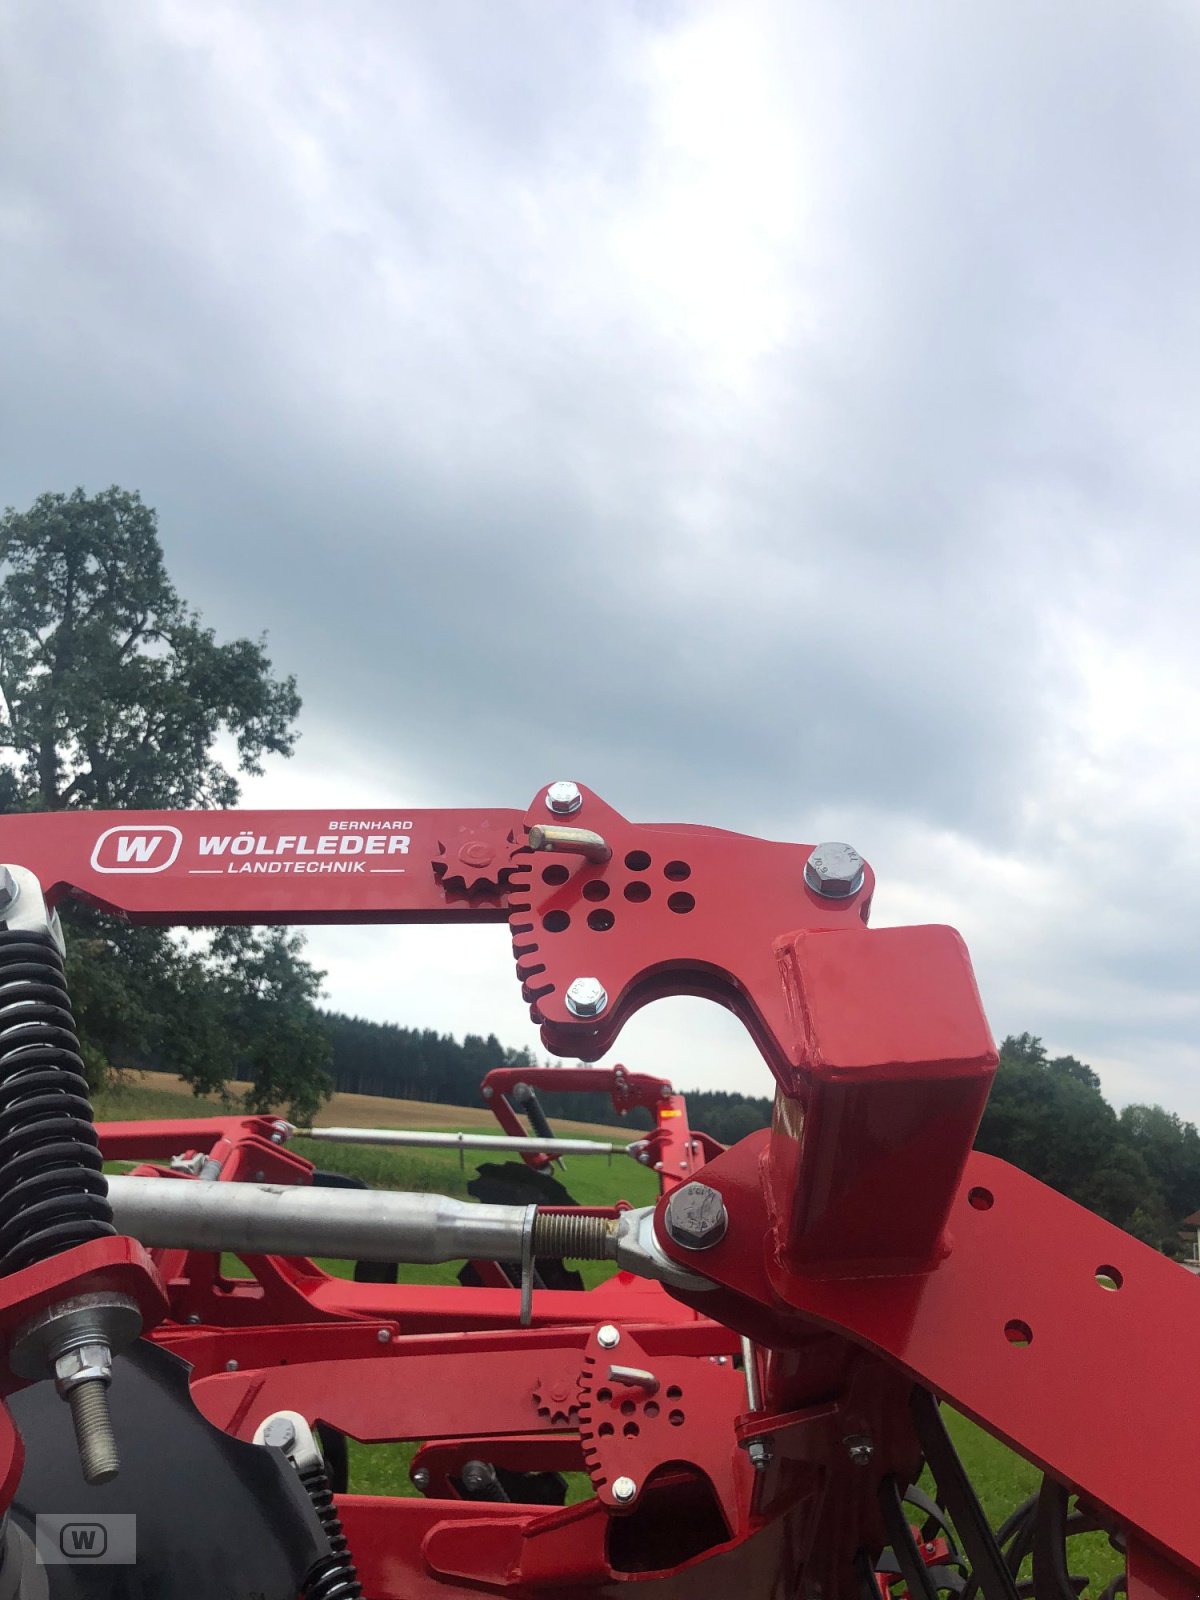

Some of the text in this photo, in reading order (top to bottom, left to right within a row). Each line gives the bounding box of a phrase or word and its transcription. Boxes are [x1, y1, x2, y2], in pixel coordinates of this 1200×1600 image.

[328, 820, 413, 831] BERNHARD
[116, 836, 163, 862] W
[198, 831, 411, 856] WÖLFLEDER
[227, 861, 367, 874] LANDTECHNIK
